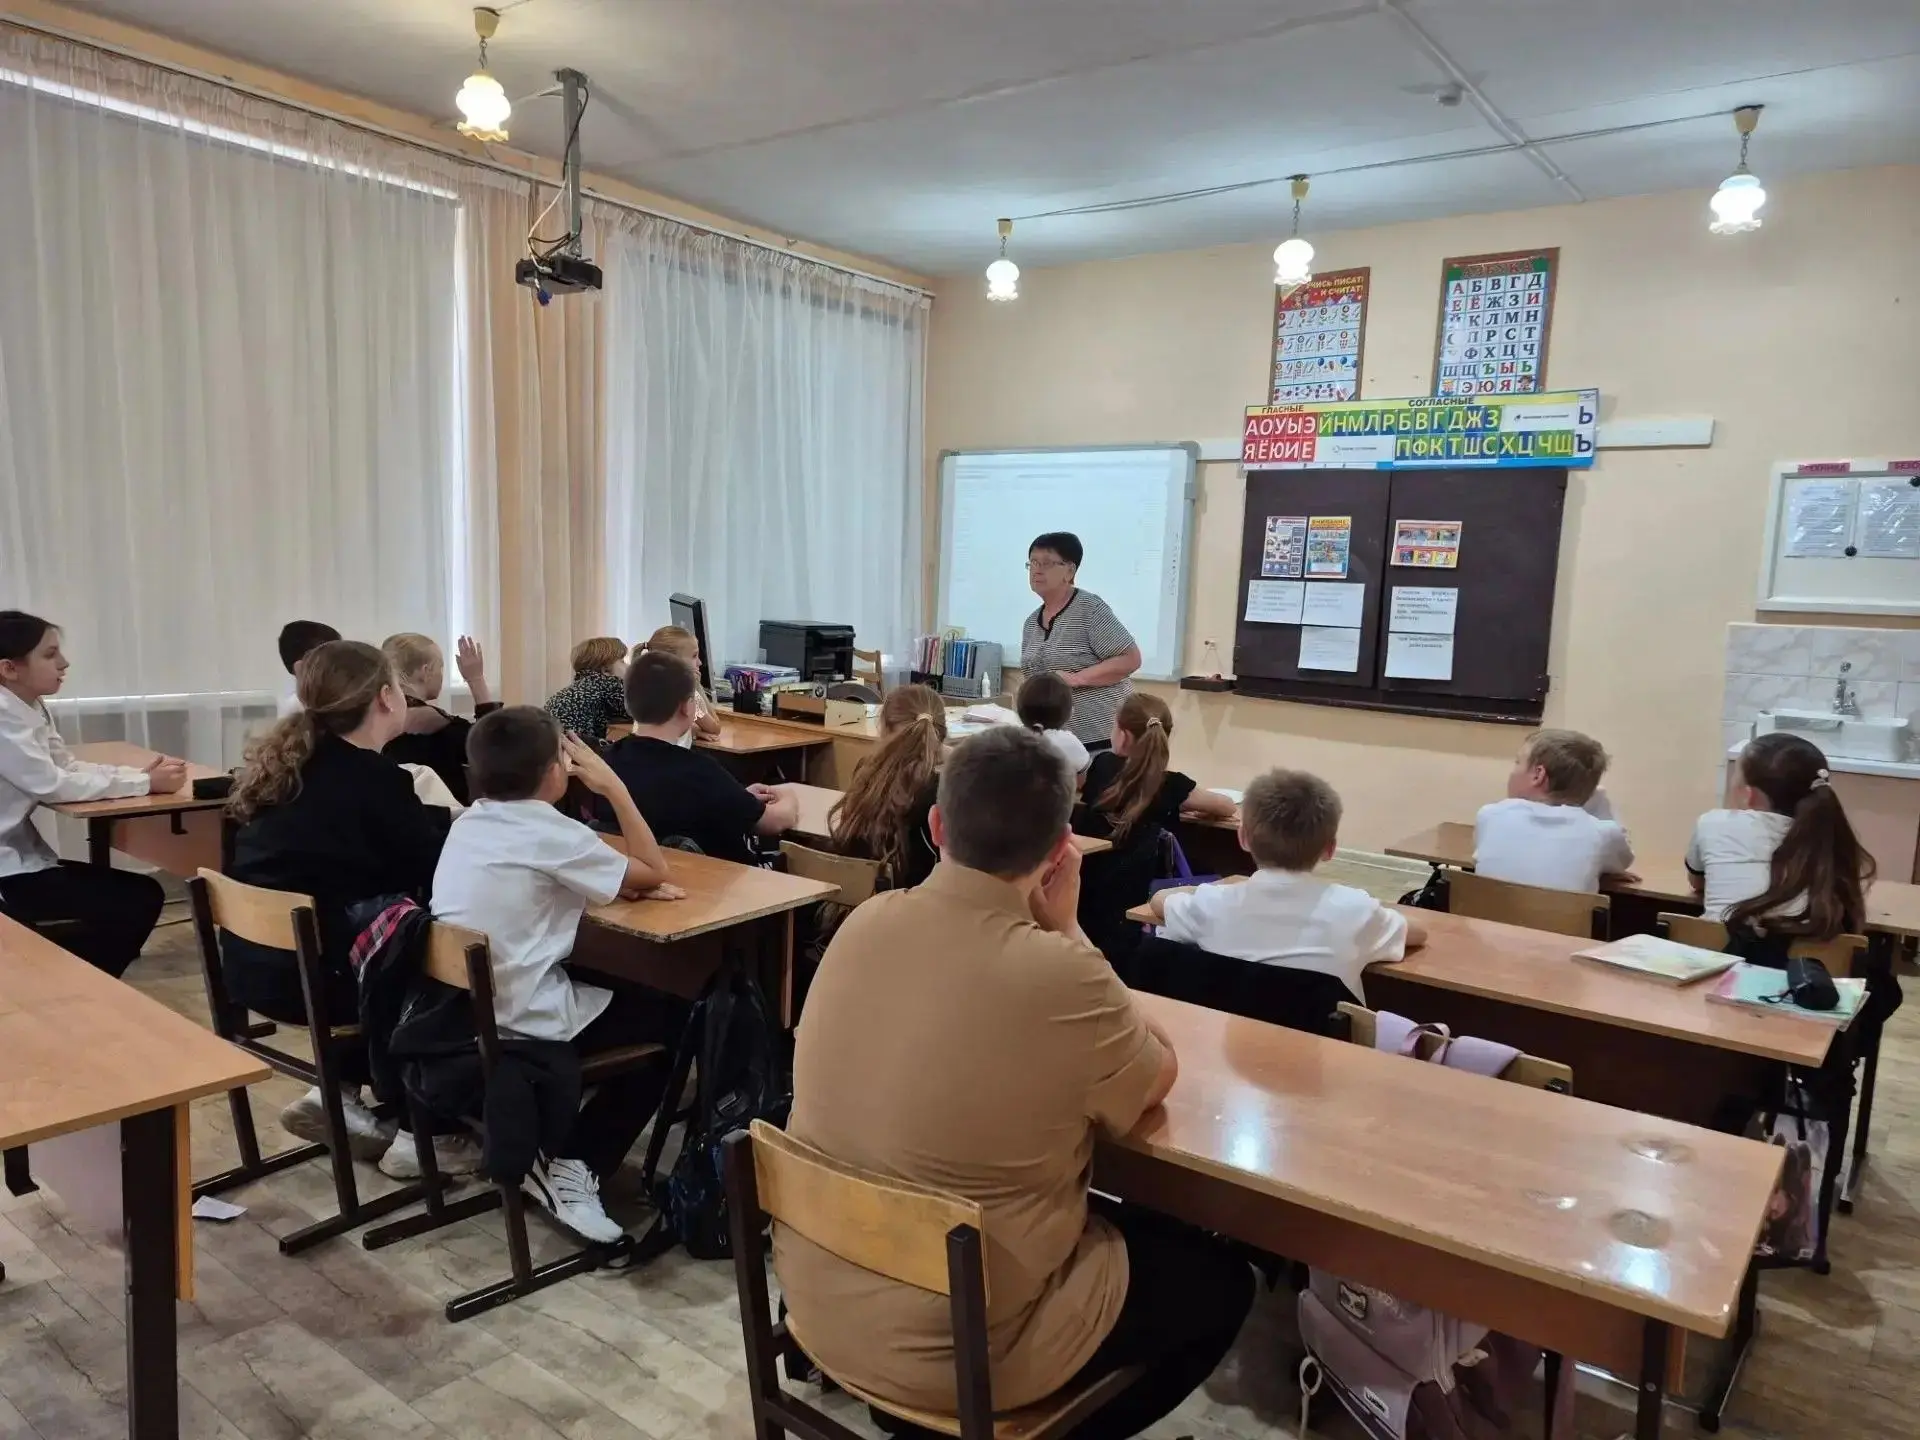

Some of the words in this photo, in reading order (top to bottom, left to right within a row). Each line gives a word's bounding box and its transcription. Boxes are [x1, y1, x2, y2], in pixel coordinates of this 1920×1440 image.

[1454, 282, 1464, 294] А
[1472, 281, 1482, 292] Б
[1491, 278, 1501, 290] В
[1510, 276, 1521, 288] Г
[1528, 274, 1541, 287] Д
[1452, 300, 1462, 312] Е
[1470, 296, 1480, 310] Ё
[1487, 296, 1502, 308] Ж
[1509, 295, 1519, 306] З
[1527, 292, 1540, 304] И
[1469, 315, 1480, 326] К
[1486, 314, 1499, 325] Л
[1505, 312, 1519, 324] М
[1525, 310, 1538, 322] Н
[1486, 330, 1496, 342] Р
[1505, 328, 1516, 340] С
[1525, 326, 1536, 338] Т
[1465, 347, 1477, 359] Ф
[1484, 347, 1496, 358] Х
[1502, 344, 1515, 358] Ц
[1523, 344, 1535, 355] Ч
[1443, 366, 1457, 376] Ш
[1462, 365, 1476, 377] Щ
[1483, 363, 1495, 375] Ъ
[1500, 362, 1515, 374] Ы
[1521, 360, 1532, 372] Ь
[1462, 382, 1472, 393] Э
[1478, 380, 1494, 392] Ю
[1499, 379, 1511, 391] Я
[1262, 405, 1304, 413] ГЛАСНЫЕ
[1408, 398, 1474, 407] СОГЛАСНЫЕ
